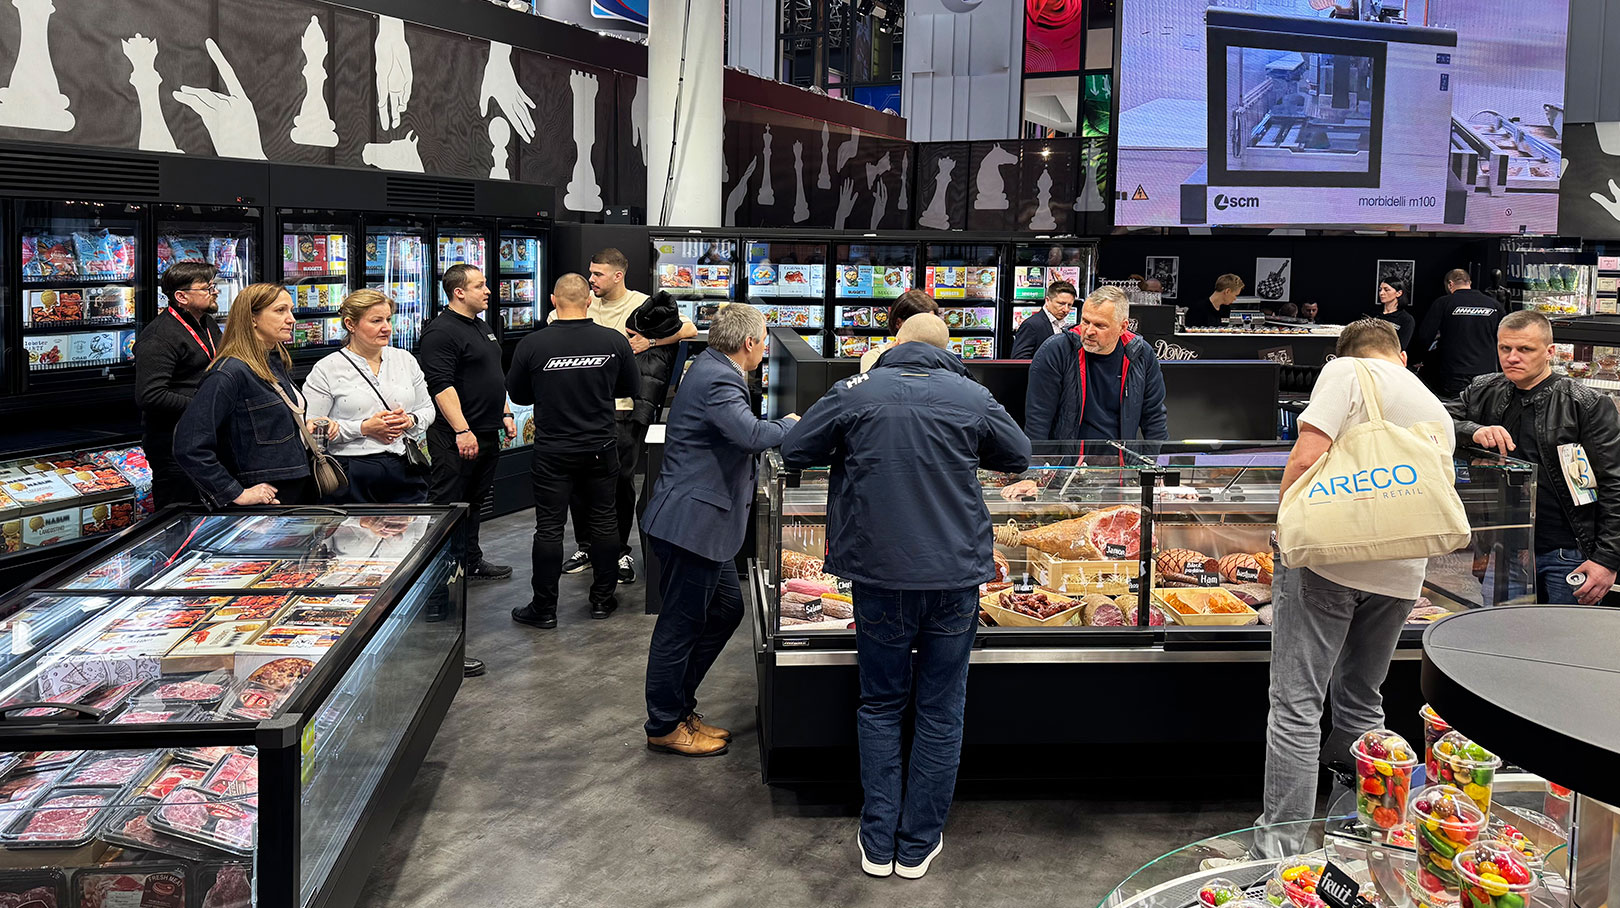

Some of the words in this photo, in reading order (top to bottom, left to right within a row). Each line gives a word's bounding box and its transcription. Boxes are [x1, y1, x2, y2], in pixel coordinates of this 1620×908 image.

[1229, 197, 1259, 208] scm
[1358, 195, 1406, 207] morbidelli
[1409, 196, 1436, 207] m100
[1308, 464, 1418, 498] ARECO
[1383, 488, 1423, 499] RETAIL
[1200, 575, 1218, 584] Ham
[148, 874, 169, 883] FRESH
